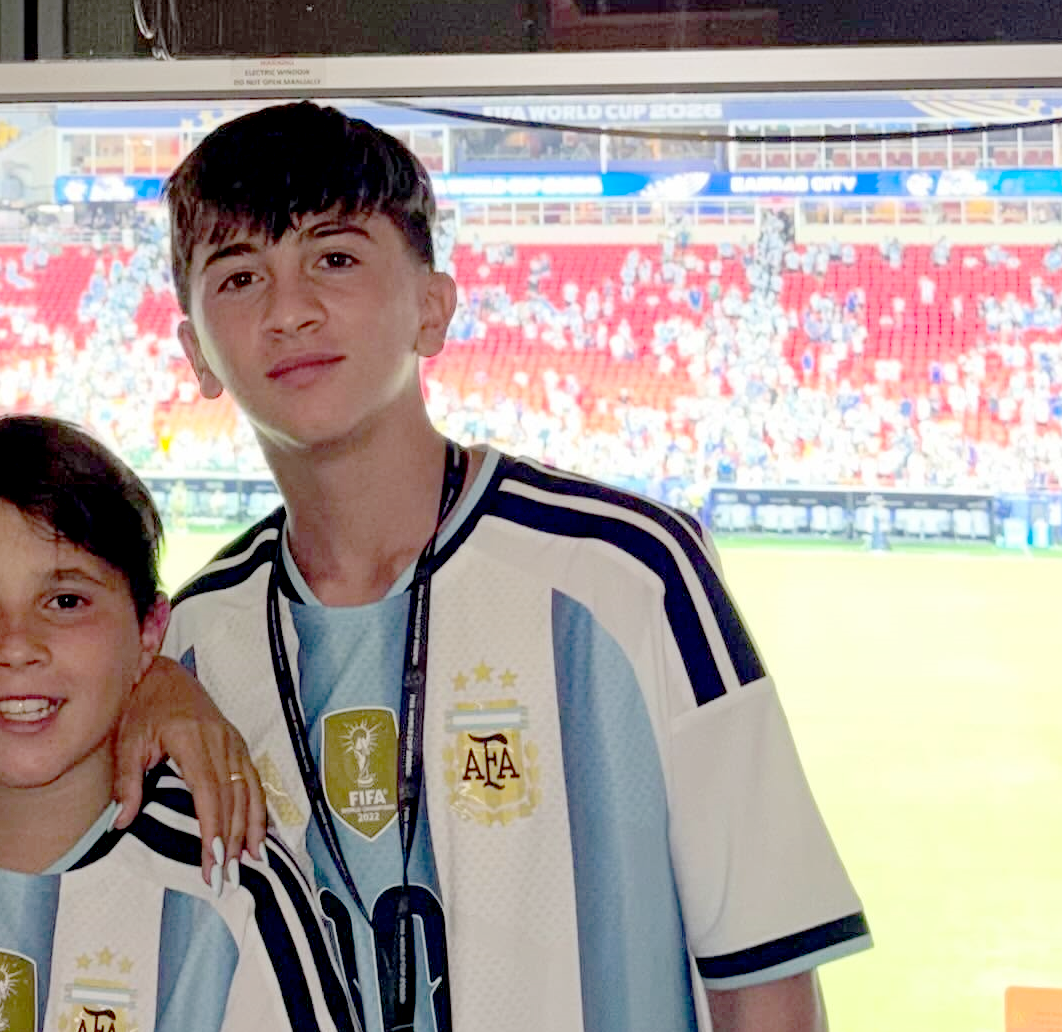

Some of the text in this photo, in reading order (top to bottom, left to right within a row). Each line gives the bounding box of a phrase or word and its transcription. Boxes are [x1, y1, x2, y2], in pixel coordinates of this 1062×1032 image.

[528, 104, 604, 121] WORLD
[605, 103, 649, 120] CUP
[649, 102, 723, 119] 2026
[462, 733, 520, 790] AFA
[349, 789, 387, 807] FIFA
